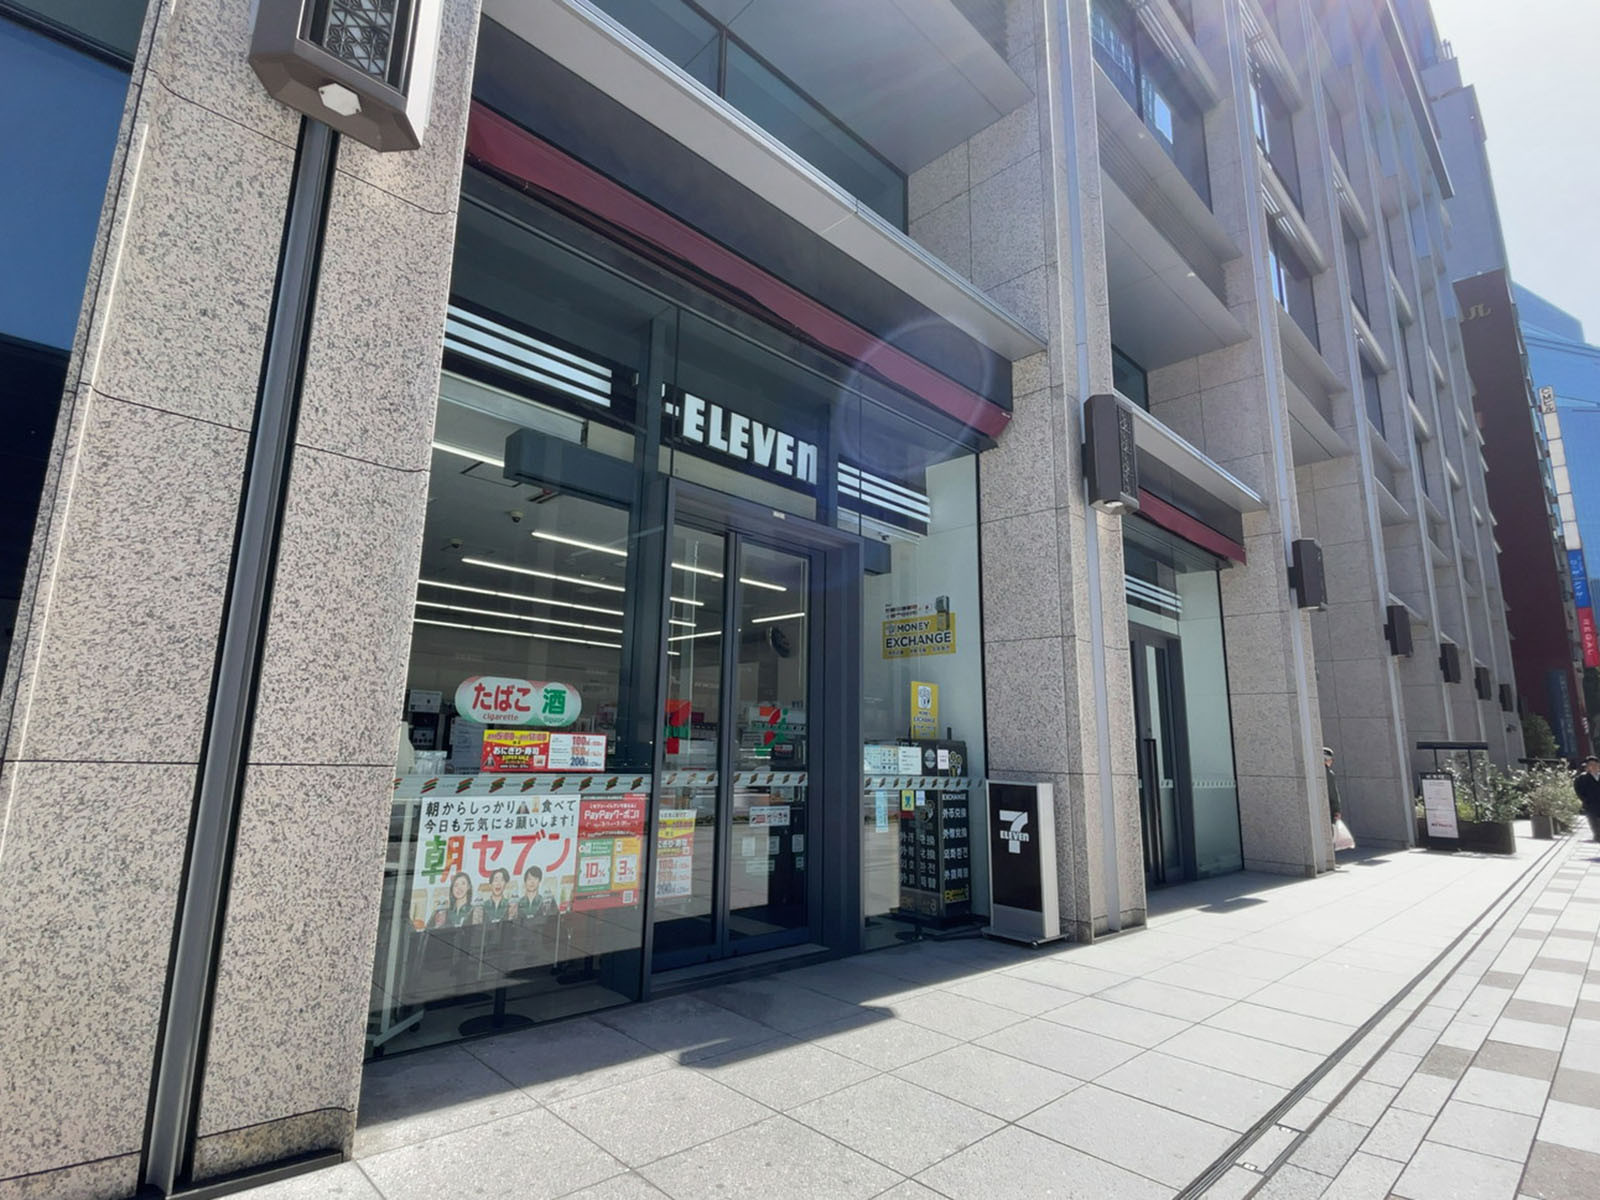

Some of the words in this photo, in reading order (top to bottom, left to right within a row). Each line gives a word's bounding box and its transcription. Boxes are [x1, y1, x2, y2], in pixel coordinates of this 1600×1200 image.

[897, 621, 930, 633] MONEY
[886, 631, 951, 648] EXCHANGE
[472, 682, 531, 712] たばこ
[542, 688, 566, 715] 酒
[483, 712, 518, 722] cigarette
[425, 801, 516, 817] 朝からしっかり
[542, 799, 577, 813] 食べて
[999, 809, 1029, 854] 7
[421, 829, 571, 885] 朝セブン
